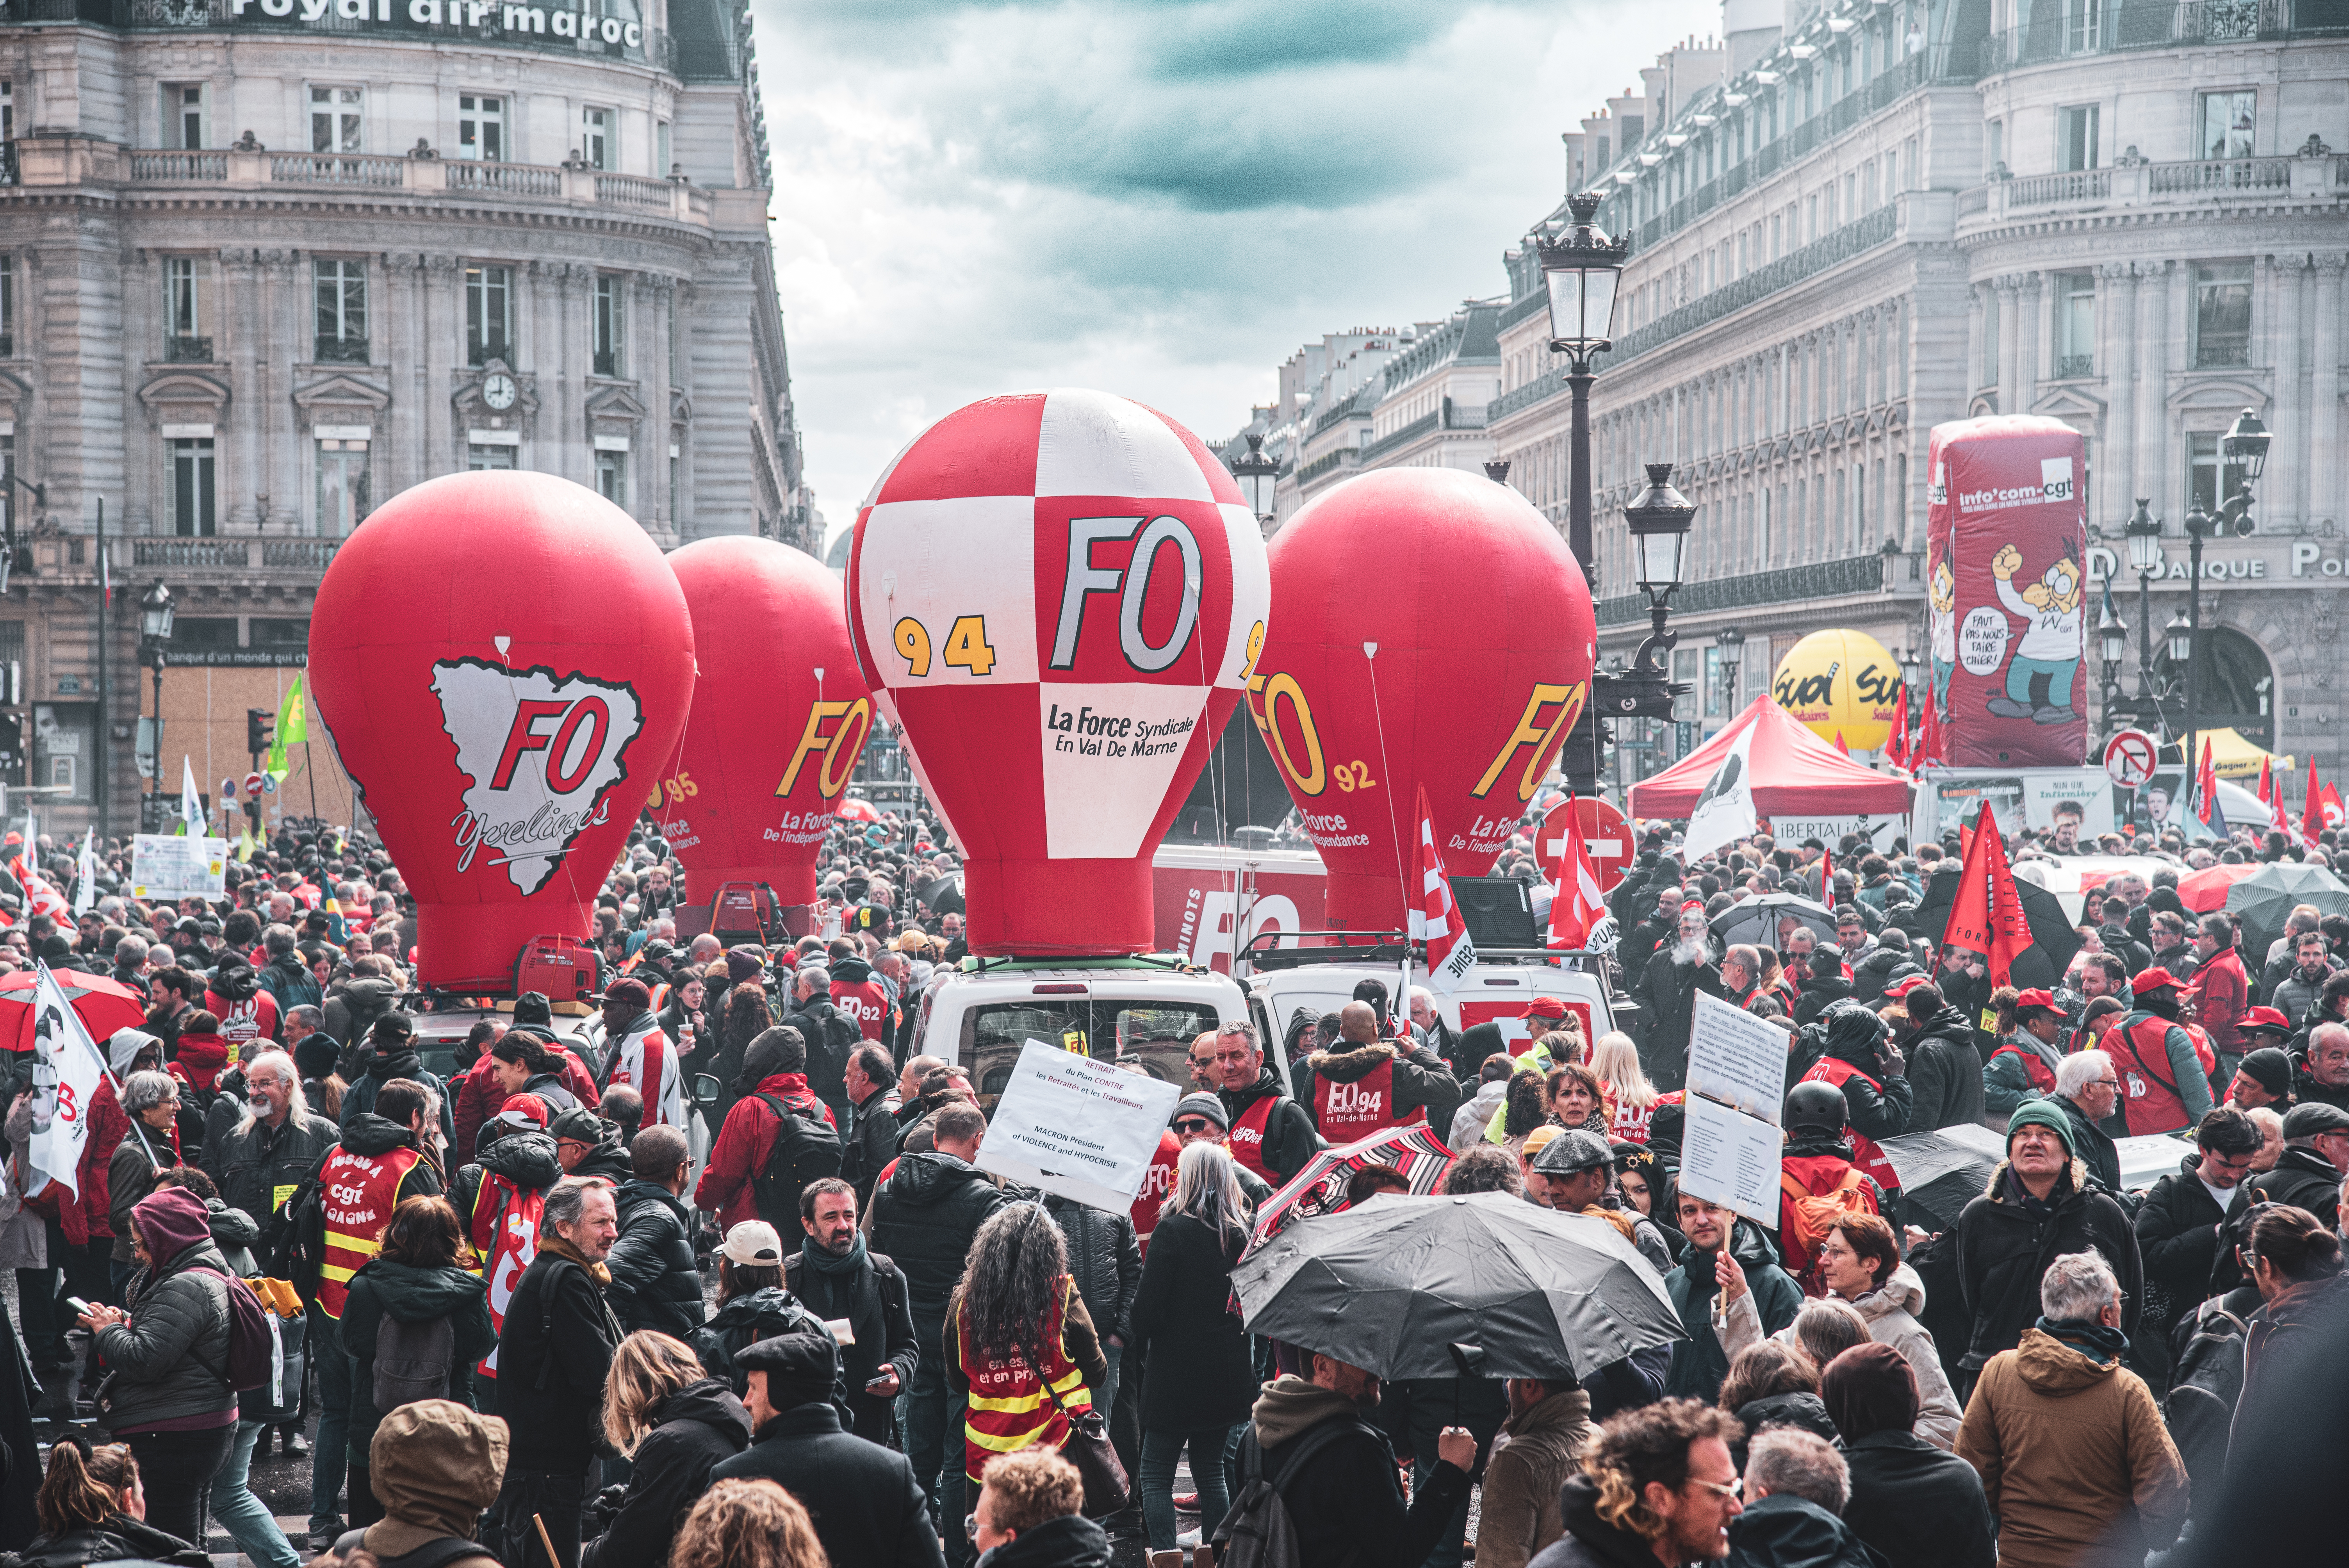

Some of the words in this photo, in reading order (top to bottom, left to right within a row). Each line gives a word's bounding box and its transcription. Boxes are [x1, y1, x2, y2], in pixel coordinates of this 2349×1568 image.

[503, 5, 640, 47] maroc
[1985, 502, 1997, 510] DANS
[1048, 515, 1204, 674] FO
[1973, 615, 1995, 627] FAUT
[893, 614, 996, 677] 94
[1966, 629, 1980, 641] PAS
[1982, 628, 2004, 639] NOUS
[167, 652, 205, 664] banque
[234, 652, 271, 663] monde
[275, 653, 292, 665] qui
[1048, 704, 1072, 731] La
[1077, 706, 1131, 738] Force
[1135, 717, 1193, 741] Syndicale
[489, 696, 610, 794] FO
[773, 697, 870, 800] FO
[1055, 734, 1073, 753] En
[1079, 738, 1101, 756] Val
[1107, 741, 1126, 757] De
[1131, 739, 1177, 757] Marne
[1468, 679, 1586, 803] FO
[1333, 760, 1376, 792] 92
[2215, 762, 2247, 771] Gagner
[665, 772, 698, 803] 95
[781, 811, 800, 829] La
[1470, 815, 1494, 837] La
[450, 797, 610, 873] Yvelines
[763, 828, 780, 841] De
[1449, 834, 1466, 850] De
[1192, 891, 1300, 977] FO
[1713, 1005, 1730, 1017] Surdité
[1736, 1016, 1752, 1025] risque
[1710, 1015, 1729, 1026] difficultés
[1741, 1028, 1768, 1043] communication
[1724, 1028, 1743, 1041] isolement
[1071, 1040, 1085, 1053] FO
[1696, 1044, 1716, 1056] difficultés
[1702, 1038, 1715, 1048] risque
[1723, 1046, 1732, 1054] celui
[1738, 1053, 1764, 1068] renfermement
[1714, 1033, 1734, 1046] personnes
[1736, 1042, 1750, 1053] sourdes
[1066, 1068, 1076, 1076] du
[1076, 1071, 1093, 1082] Plan
[1095, 1077, 1125, 1090] CONTRE
[1085, 1061, 1116, 1075] RETRAIT
[1694, 1062, 1710, 1072] peuvent
[1720, 1072, 1750, 1087] dommageables
[1695, 1053, 1722, 1068] conséquences
[1724, 1065, 1754, 1080] psychologiques
[1760, 1080, 1773, 1090] sociales
[1036, 1071, 1046, 1080] les
[1048, 1076, 1080, 1091] Retraités
[1091, 1089, 1100, 1097] les
[1103, 1092, 1143, 1110] Travailleurs
[1337, 1113, 1378, 1123] Val-de-Marne
[1034, 1126, 1068, 1142] MACRON
[1070, 1136, 1105, 1151] President
[1022, 1135, 1057, 1151] VIOLENCE
[1058, 1147, 1073, 1156] and
[1074, 1151, 1117, 1169] HYPOCRISIE
[1146, 1163, 1170, 1194] FO
[331, 1183, 364, 1205] cgt
[327, 1208, 376, 1225] GAGNE
[980, 1372, 990, 1383] et
[994, 1371, 1009, 1383] en
